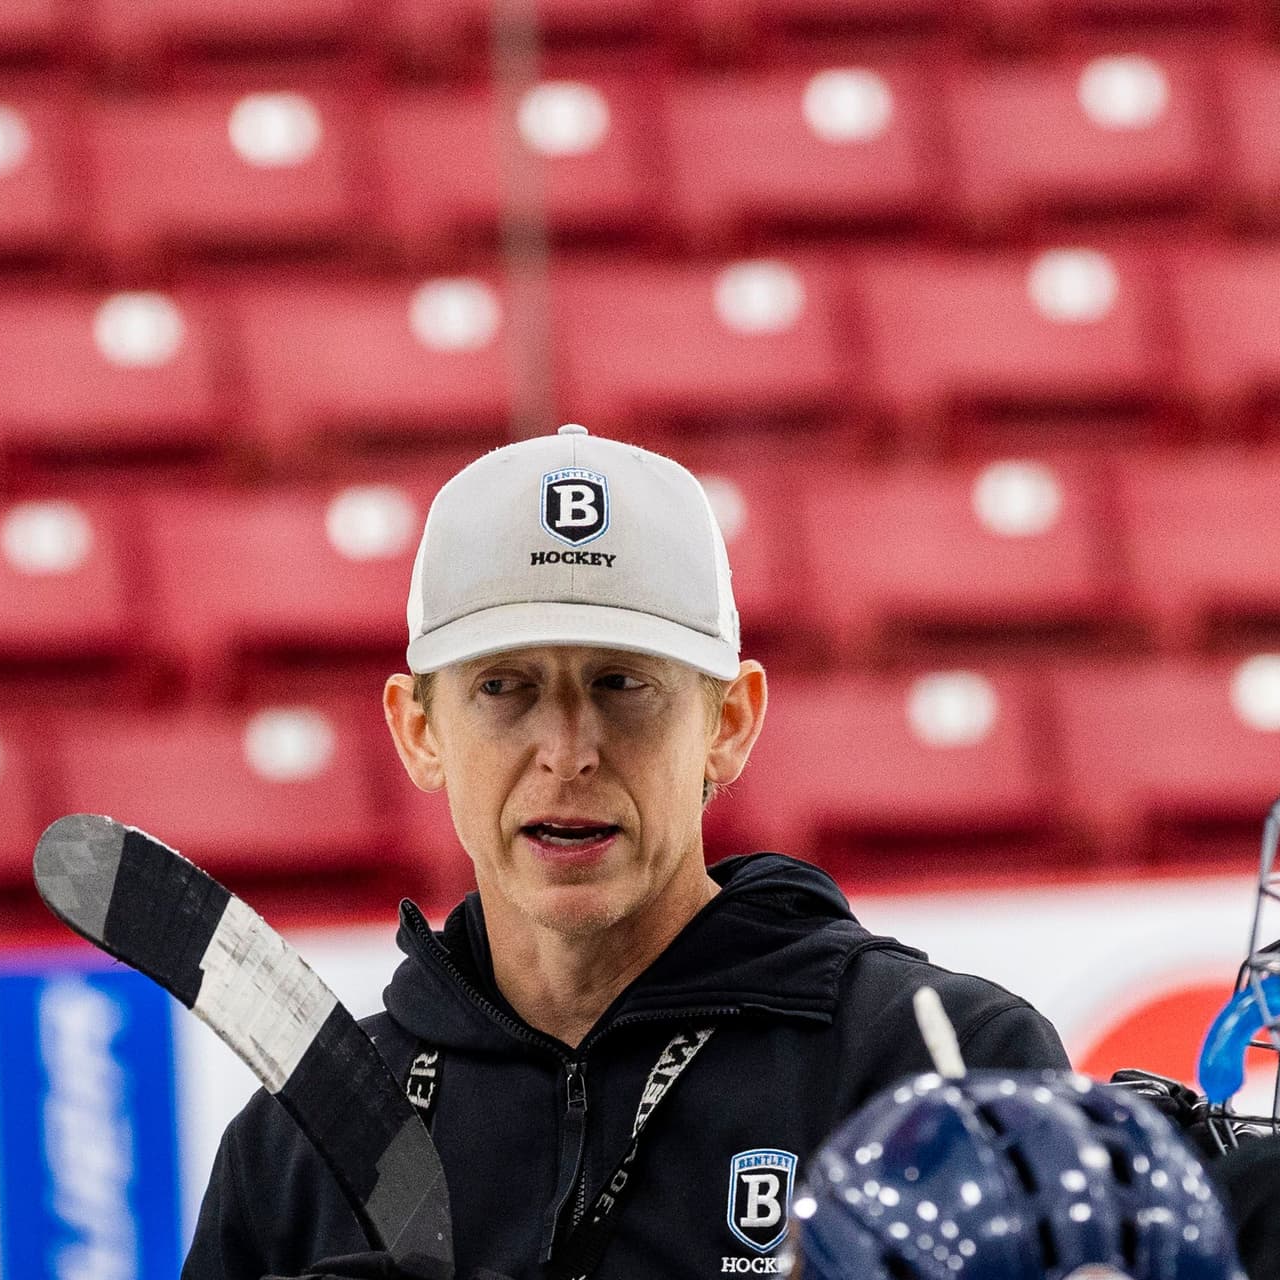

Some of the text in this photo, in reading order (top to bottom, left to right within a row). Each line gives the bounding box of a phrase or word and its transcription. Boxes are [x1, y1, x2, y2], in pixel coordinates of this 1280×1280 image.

[552, 484, 599, 528] B
[530, 551, 617, 568] HOCKEY
[738, 1155, 789, 1169] BENTLEY
[740, 1173, 781, 1227] B
[720, 1257, 786, 1273] HOCK
